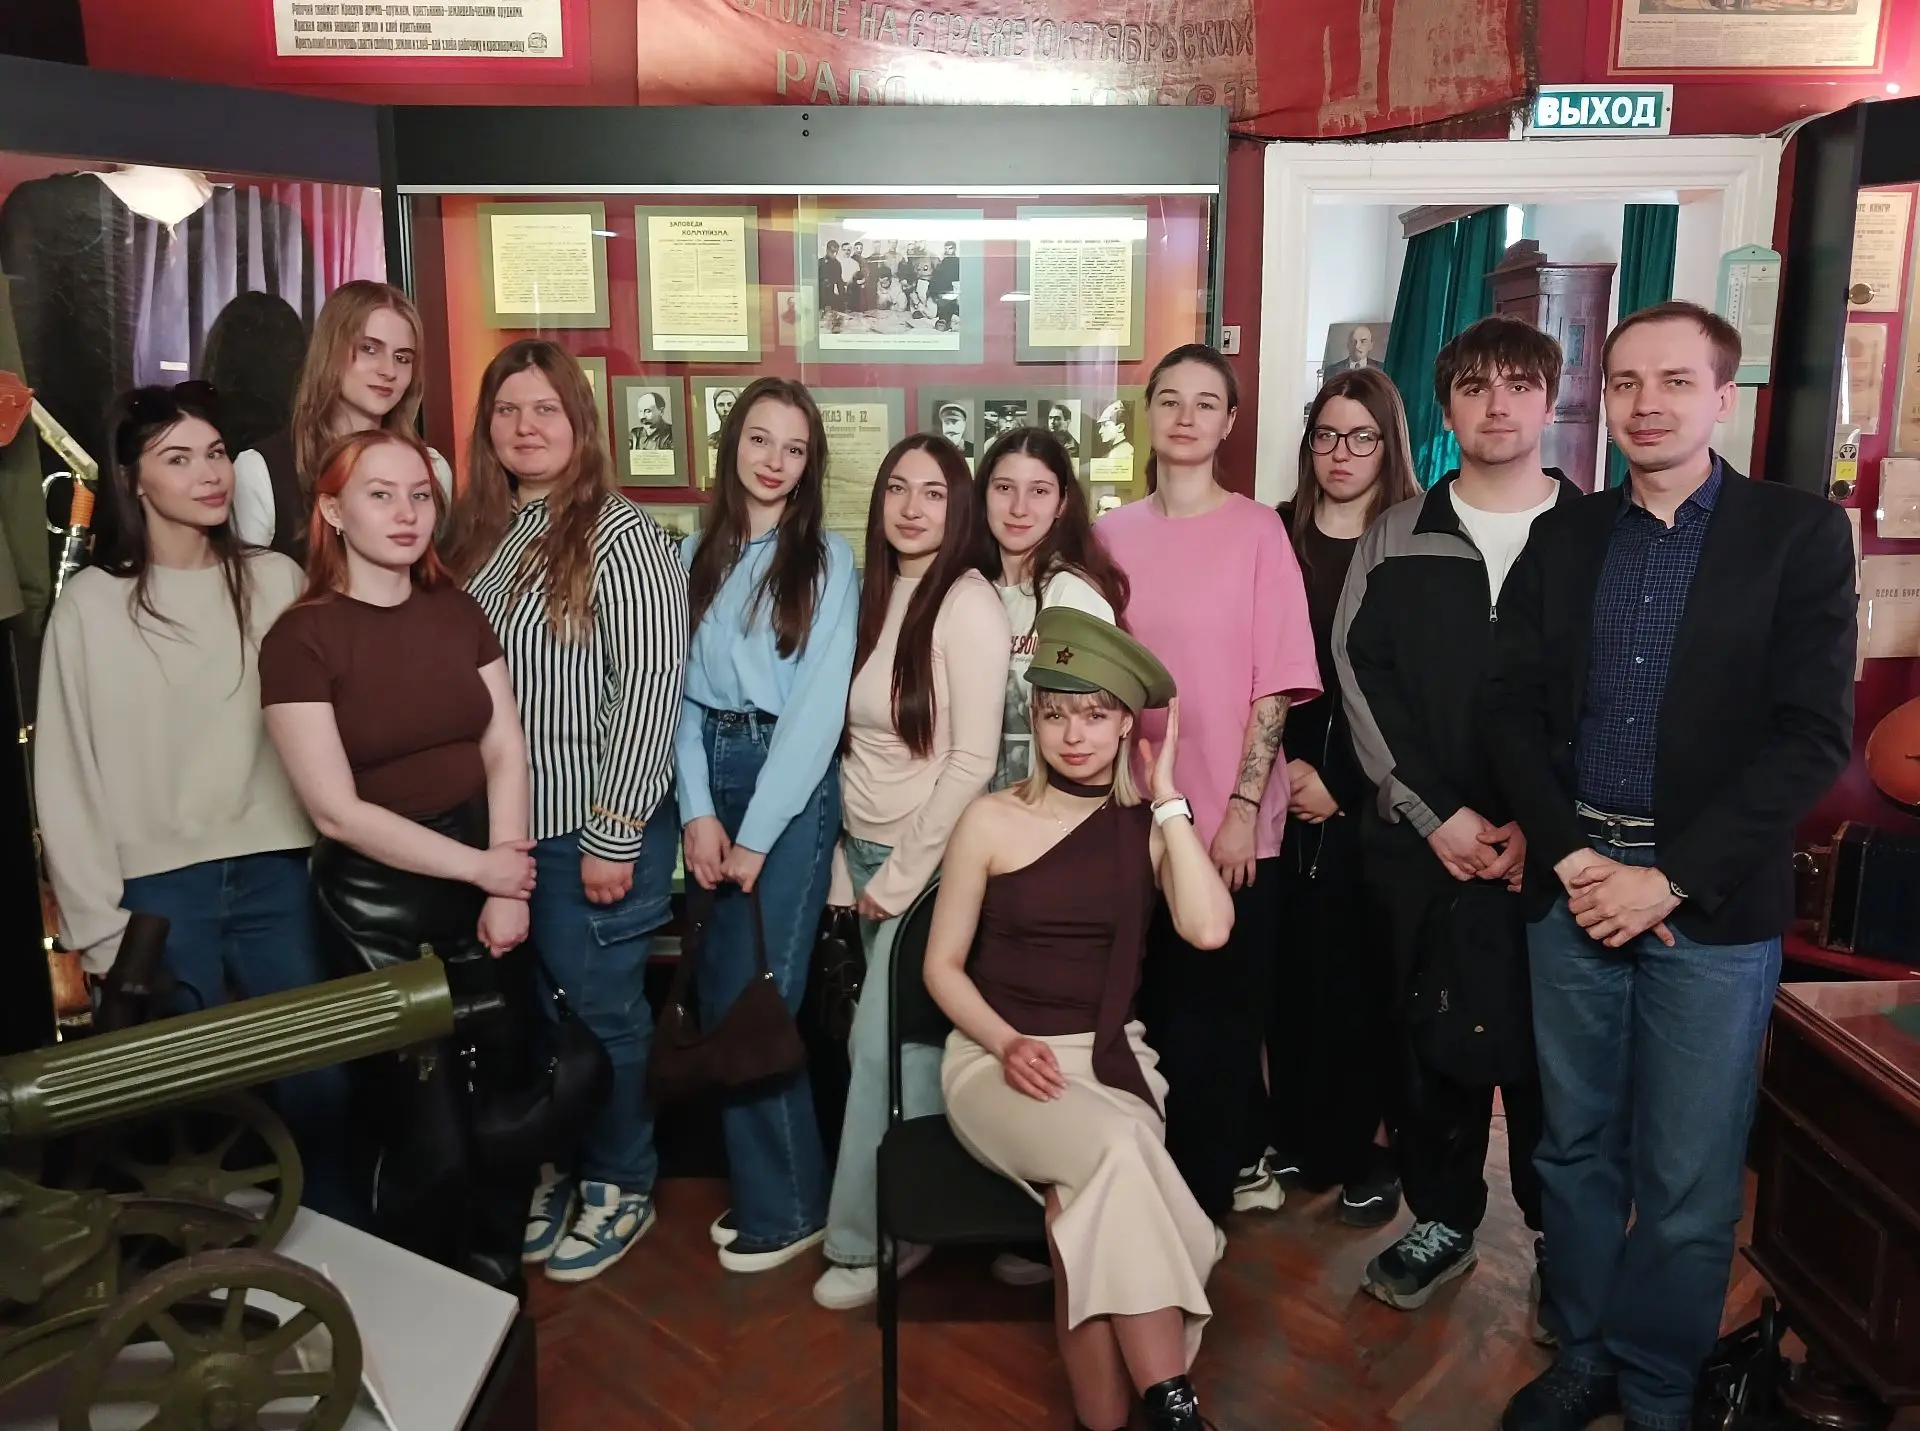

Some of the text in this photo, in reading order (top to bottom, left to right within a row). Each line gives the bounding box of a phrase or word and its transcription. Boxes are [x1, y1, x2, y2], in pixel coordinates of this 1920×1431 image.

[858, 1, 901, 42] НА
[906, 9, 1029, 58] СТРАЖЕ
[1033, 13, 1255, 64] ОКТЯБРЬСКИХ
[1538, 96, 1656, 127] ВЫХОД
